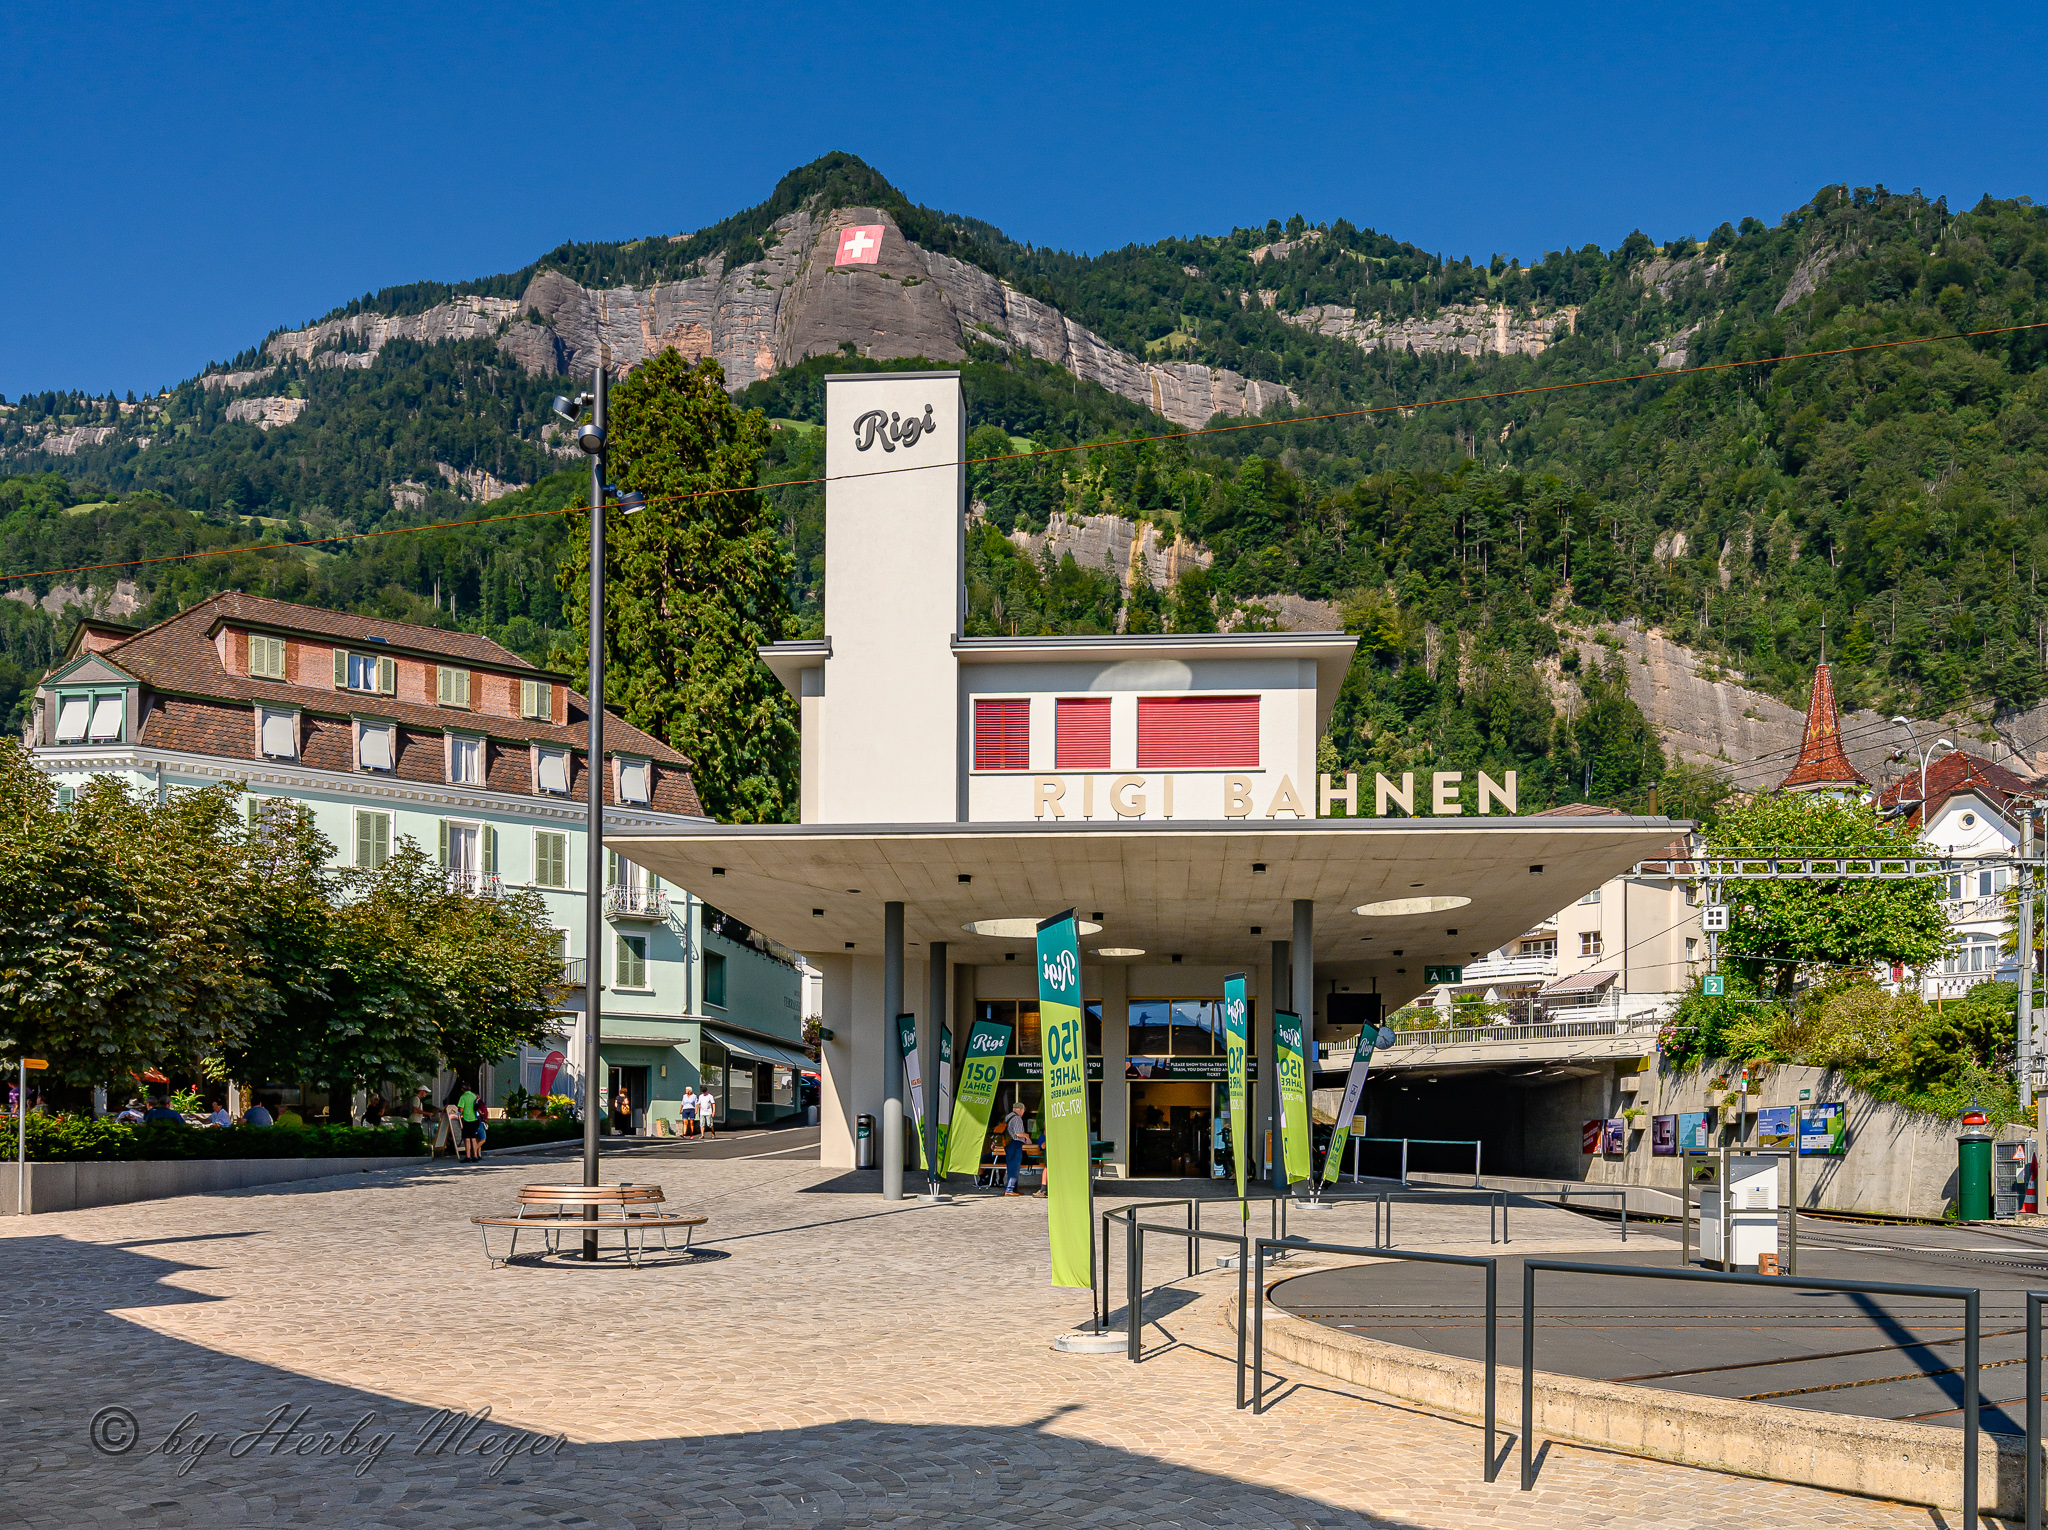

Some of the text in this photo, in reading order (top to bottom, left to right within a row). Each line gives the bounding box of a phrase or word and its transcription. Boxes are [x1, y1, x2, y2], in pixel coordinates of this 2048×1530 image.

[853, 403, 937, 453] Rigi
[1033, 770, 1518, 818] RIGI BAHNEN
[1430, 971, 1440, 981] A
[1450, 971, 1455, 981] 1
[1710, 982, 1718, 992] 2
[972, 1033, 1006, 1052] Rigi
[967, 1062, 997, 1083] 150
[963, 1081, 993, 1093] JAHRE
